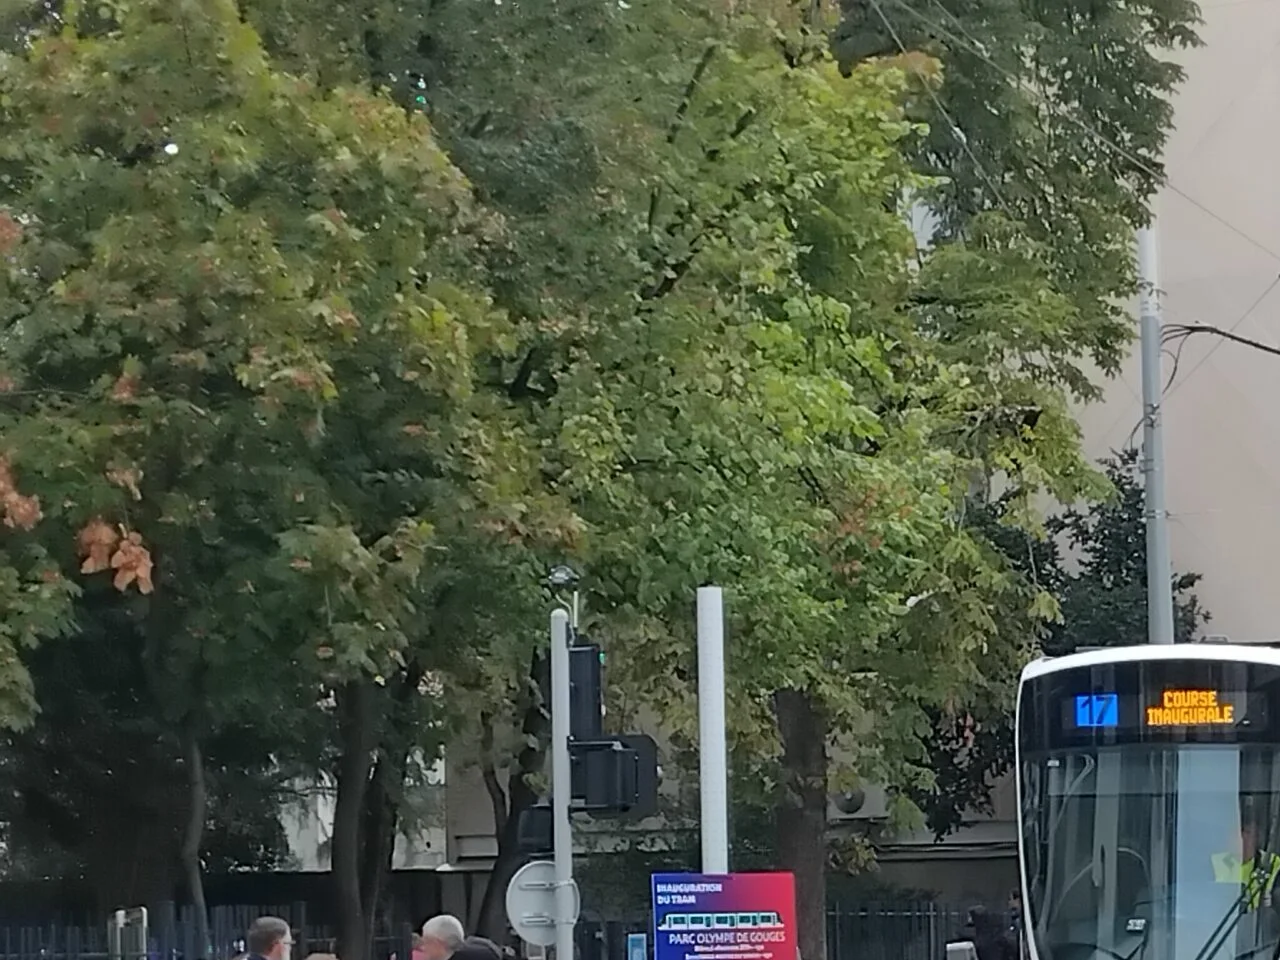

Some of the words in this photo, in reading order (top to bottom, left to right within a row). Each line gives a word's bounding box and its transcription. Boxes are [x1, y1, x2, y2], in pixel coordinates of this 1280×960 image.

[1162, 690, 1218, 707] COURSE
[1081, 695, 1114, 725] 17
[1146, 705, 1235, 726] INAUGURALE
[656, 883, 722, 893] INAUGURATION
[657, 895, 670, 904] DU
[671, 895, 696, 904] TRAM
[668, 933, 696, 944] PARC
[696, 932, 735, 944] OLYMPE
[736, 932, 749, 942] DE
[750, 931, 786, 942] GOUGES
